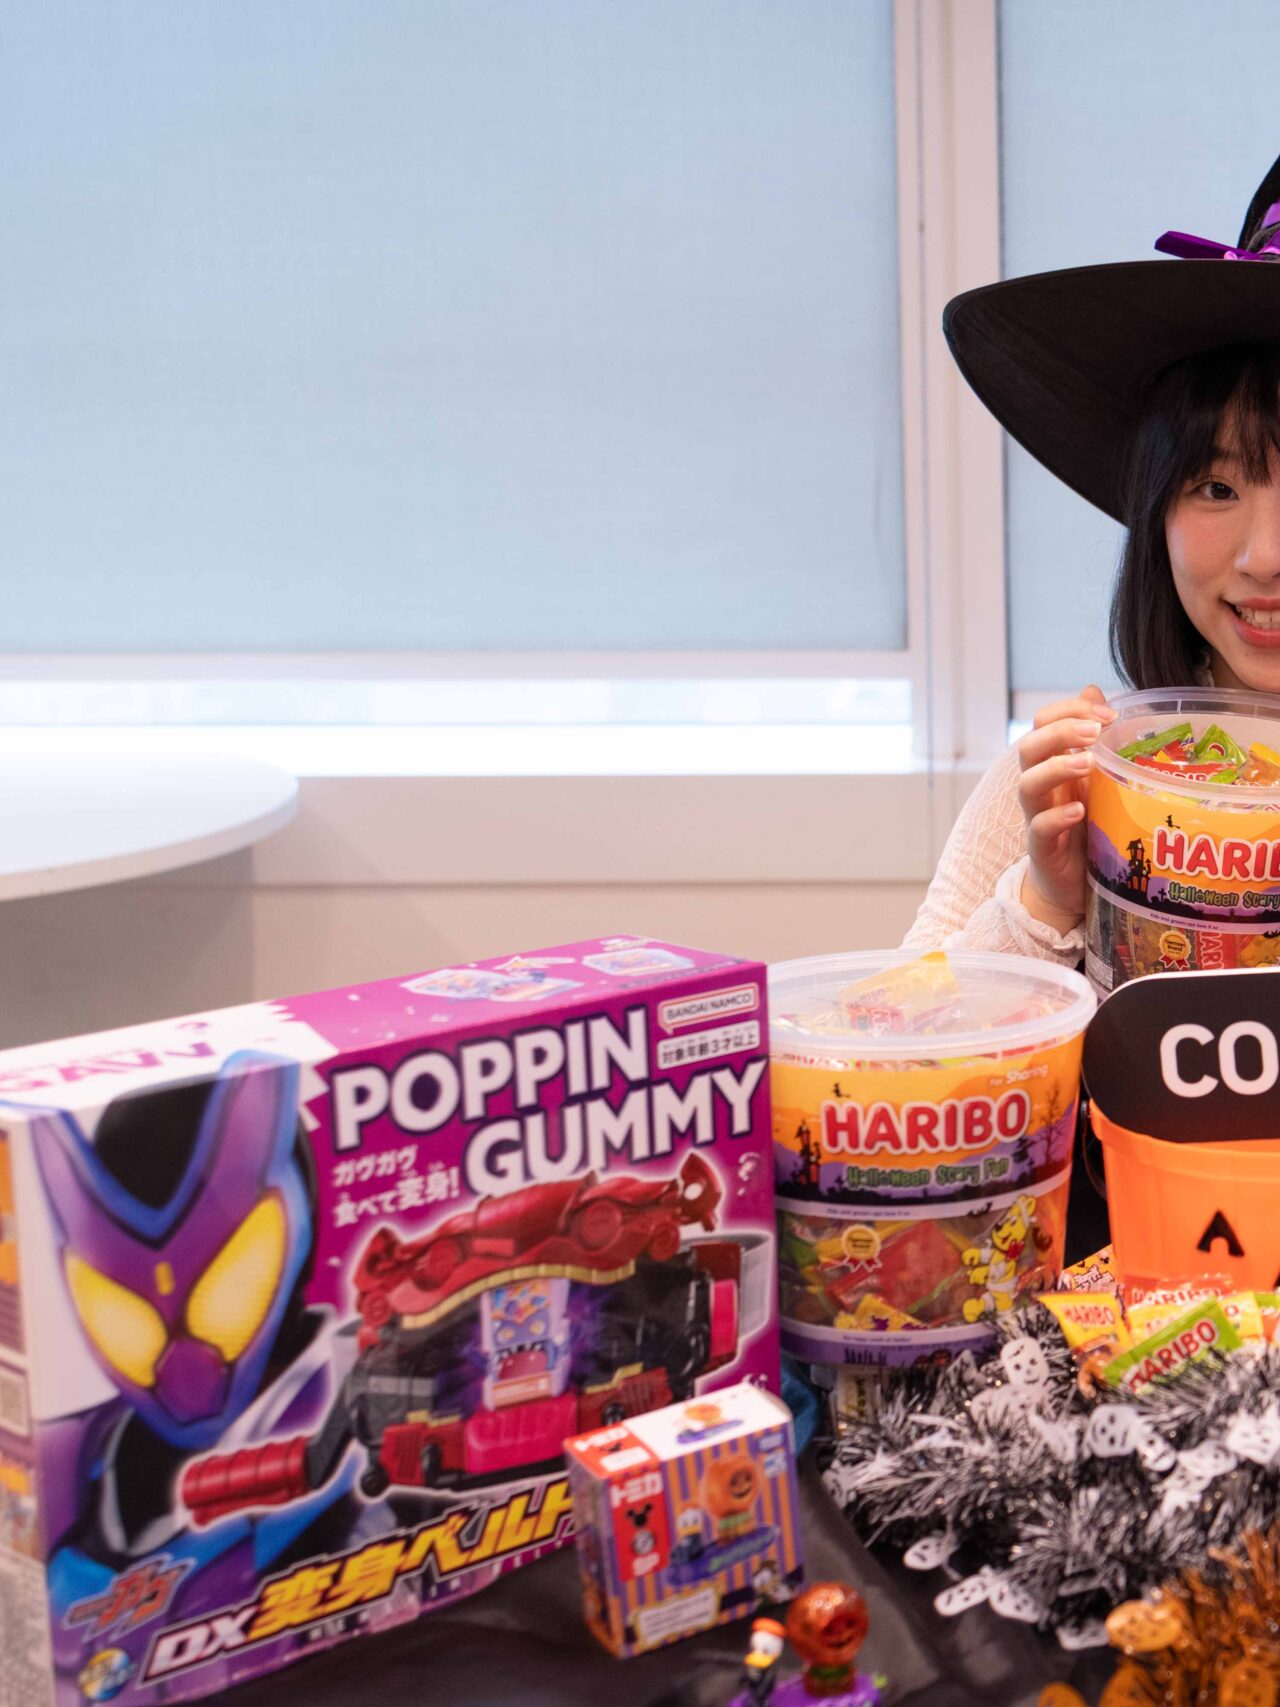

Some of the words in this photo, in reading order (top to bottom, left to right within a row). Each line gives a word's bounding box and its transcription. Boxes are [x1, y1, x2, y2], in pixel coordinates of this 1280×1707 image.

[1243, 890, 1280, 909] Scary
[710, 993, 752, 1009] NAMCO
[331, 1006, 650, 1151] POPPIN
[1006, 1064, 1048, 1084] Sharing
[466, 1060, 768, 1197] GUMMY
[822, 1091, 1029, 1154] HARIBO
